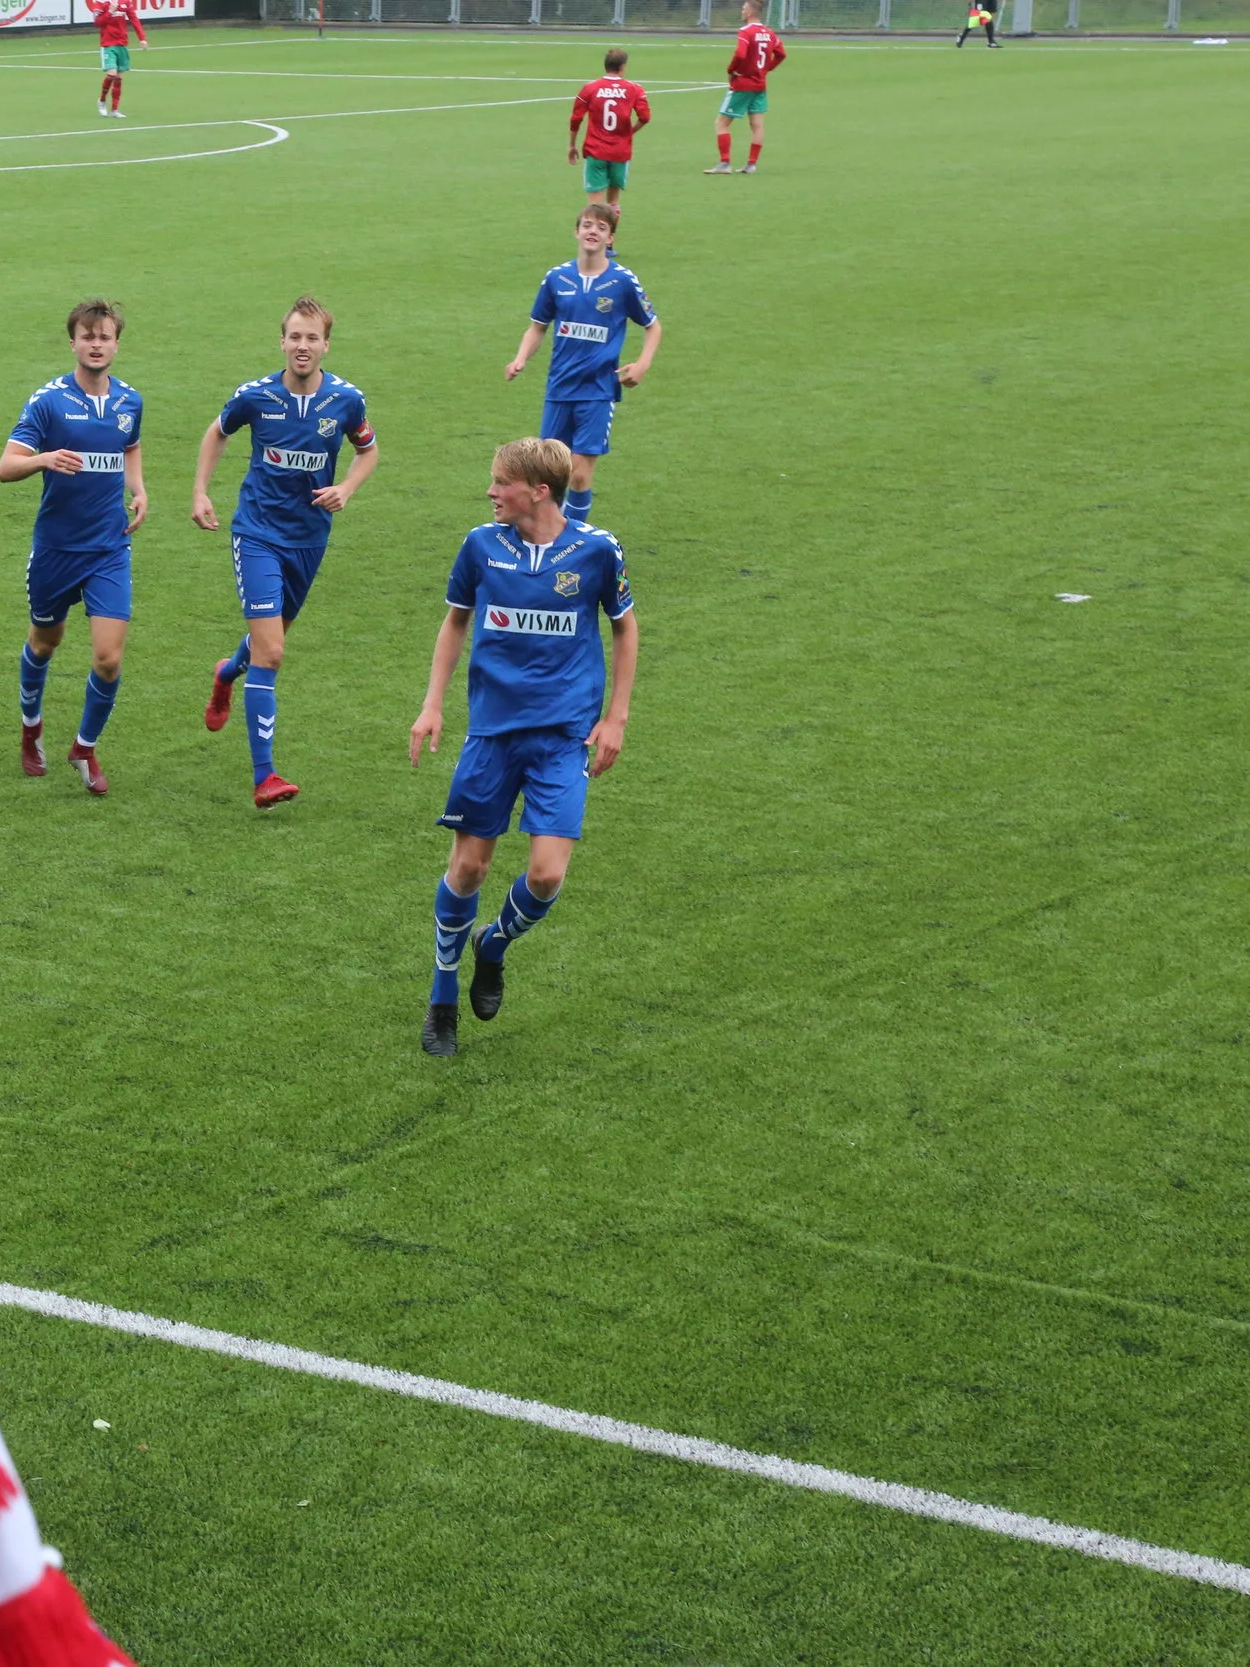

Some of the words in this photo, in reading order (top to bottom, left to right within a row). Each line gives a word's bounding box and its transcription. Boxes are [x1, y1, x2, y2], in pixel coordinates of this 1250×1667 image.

[757, 43, 768, 69] 5
[596, 88, 627, 99] ABAX
[603, 100, 617, 131] 6
[571, 324, 604, 341] VISMA
[286, 453, 324, 469] VISMA
[487, 557, 518, 571] hummel
[550, 545, 578, 565] SISSENER
[516, 612, 572, 632] VISMA
